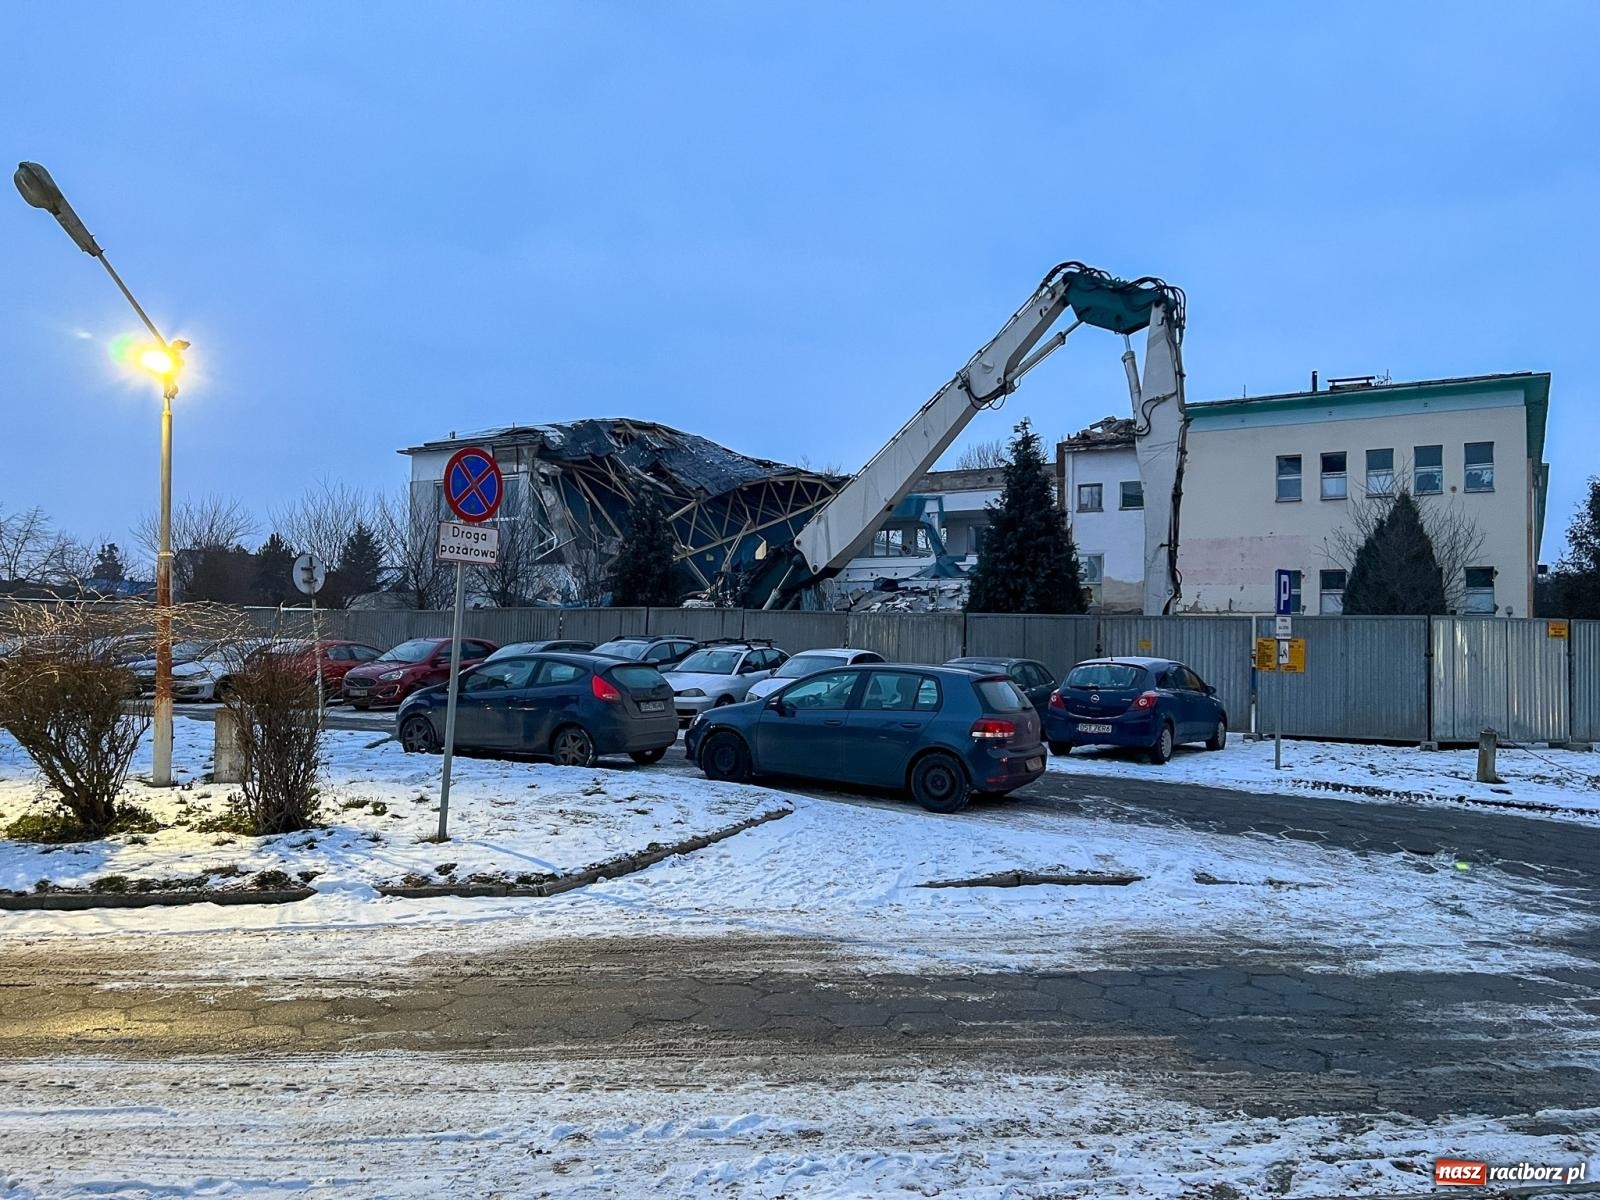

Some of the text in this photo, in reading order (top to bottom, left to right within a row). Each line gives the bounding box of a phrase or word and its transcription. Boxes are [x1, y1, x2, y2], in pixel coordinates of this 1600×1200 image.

[452, 526, 487, 544] Droga
[440, 543, 496, 559] pożarowa
[1280, 574, 1290, 611] P
